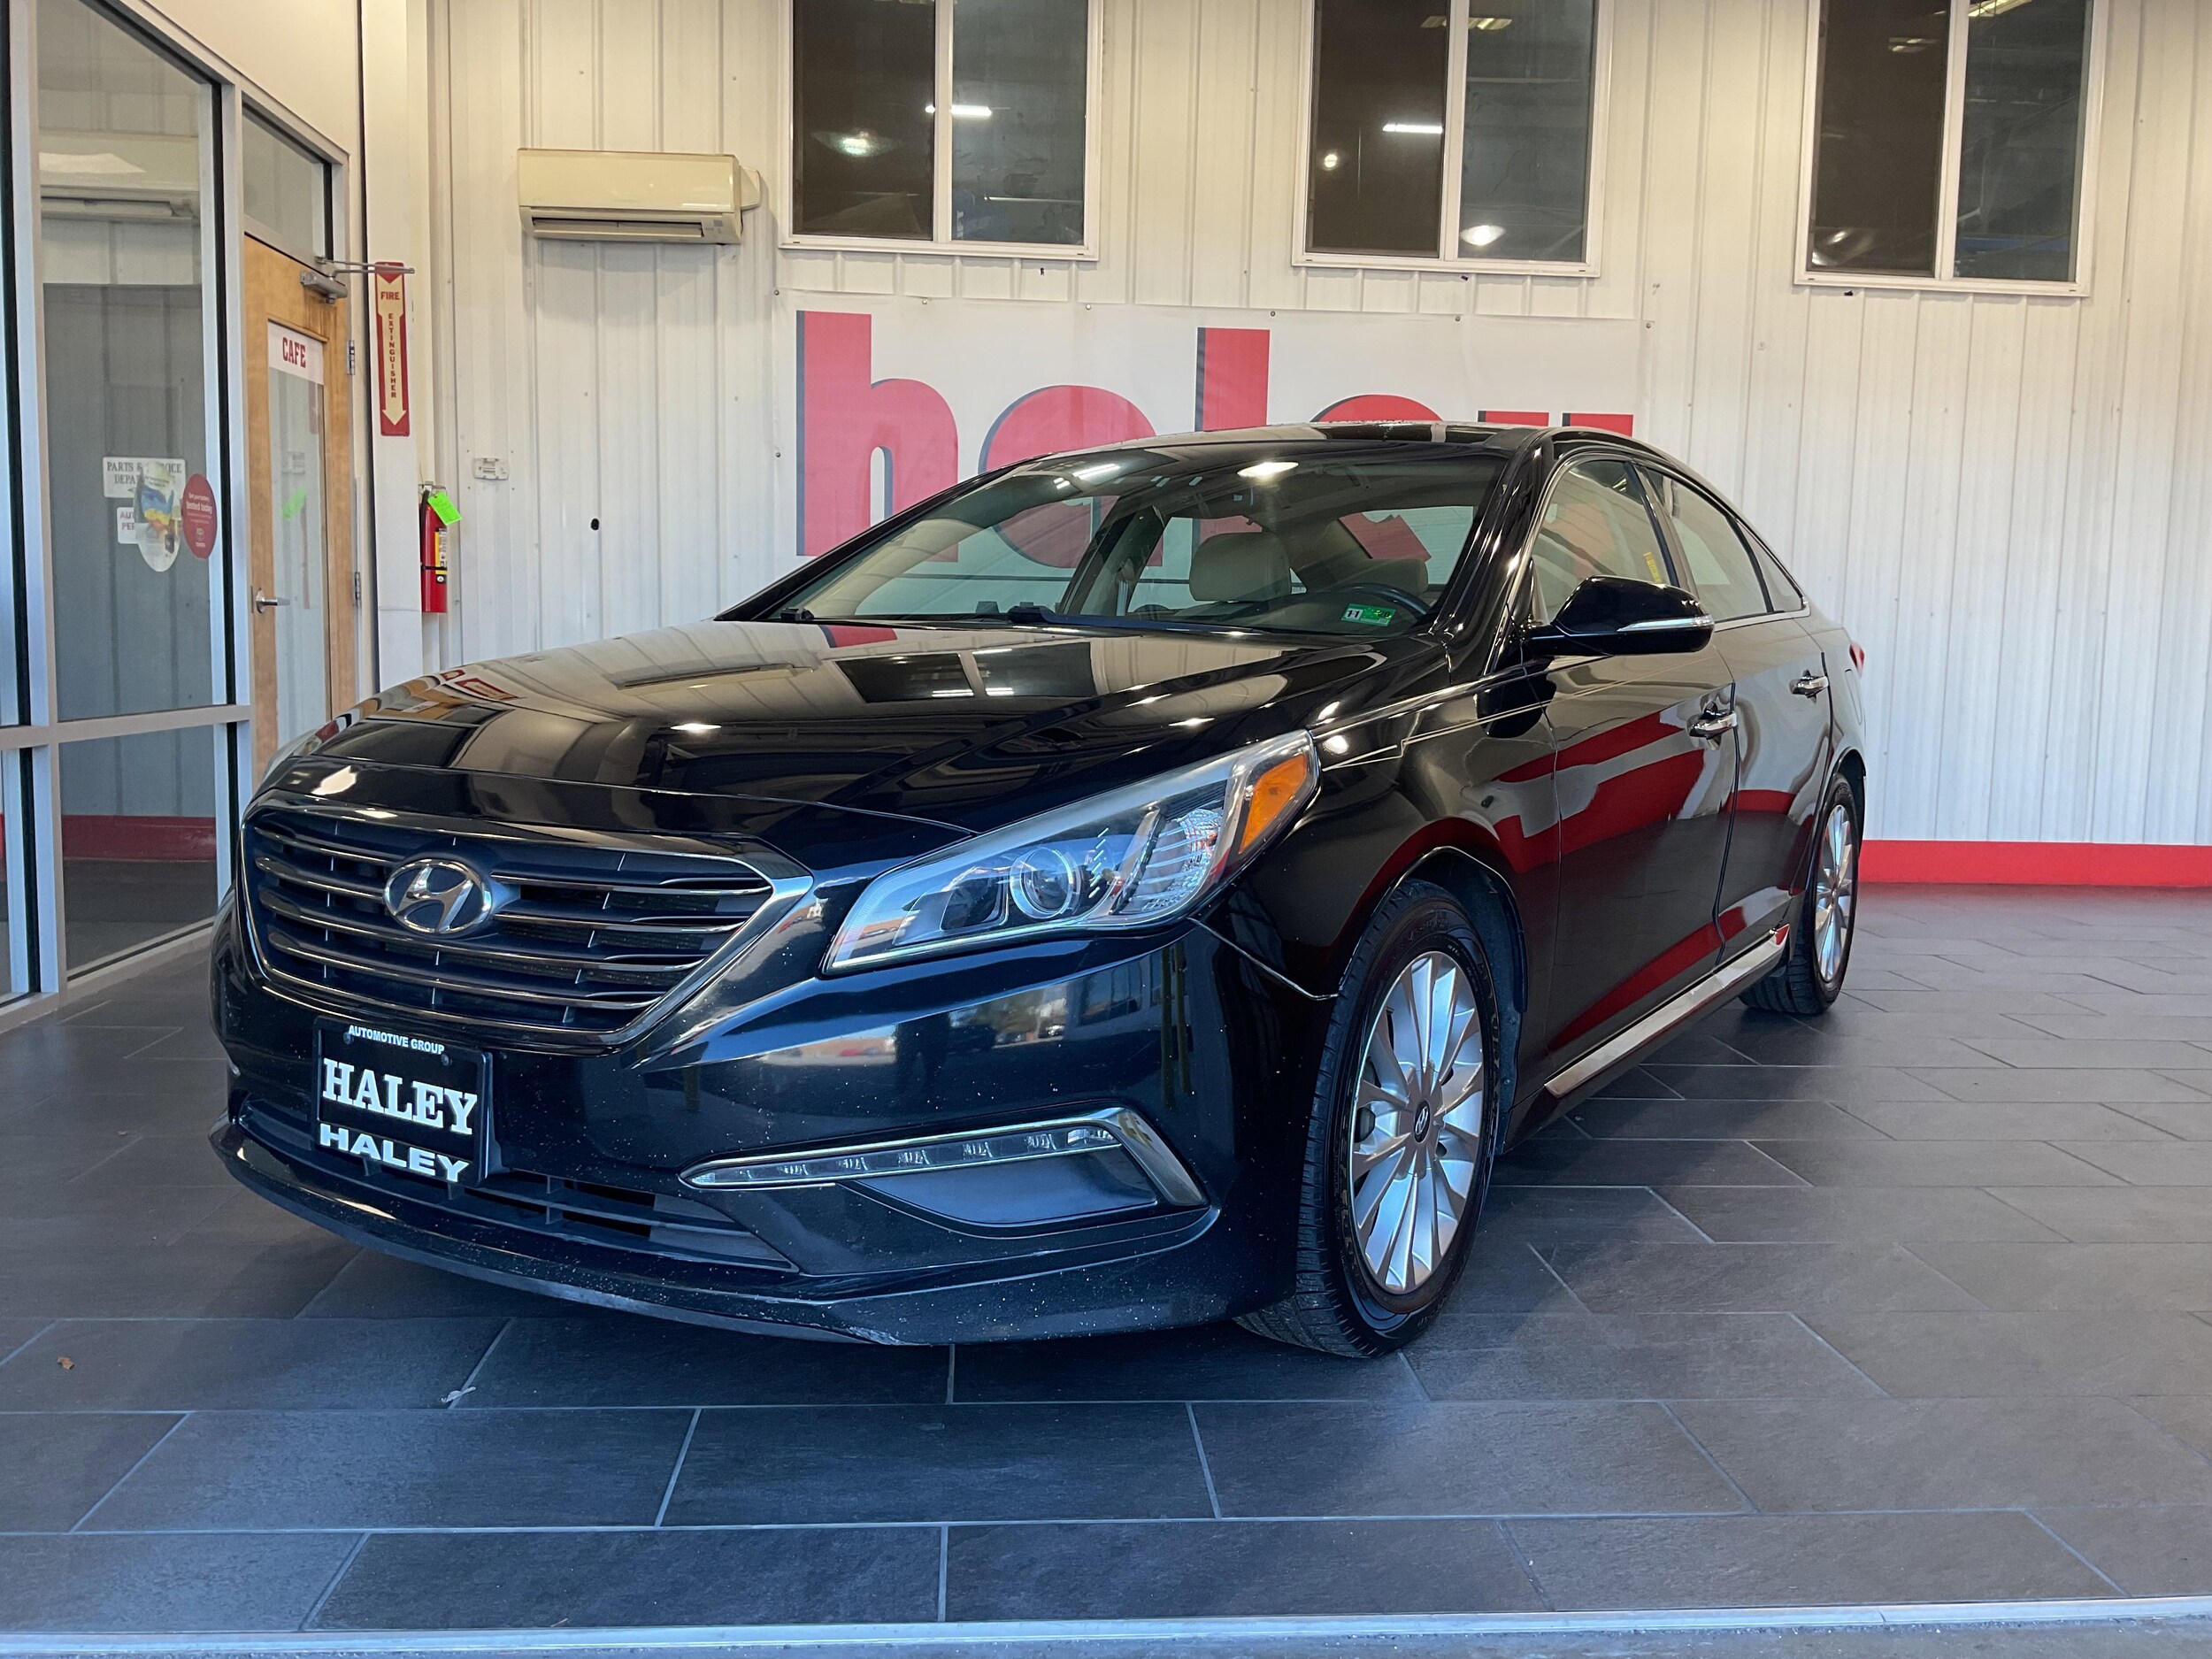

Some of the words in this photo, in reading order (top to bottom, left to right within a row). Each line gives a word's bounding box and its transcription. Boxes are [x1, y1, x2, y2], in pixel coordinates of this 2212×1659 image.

[380, 291, 400, 300] FIRE
[282, 336, 306, 368] CAFE
[388, 312, 396, 398] EXTINGUISHER
[107, 462, 134, 472] PARTS
[348, 1025, 409, 1048] AUTOMOTIVE
[411, 1038, 445, 1056] GROUP
[322, 1057, 478, 1135] HALEY
[319, 1123, 470, 1183] HALEY
